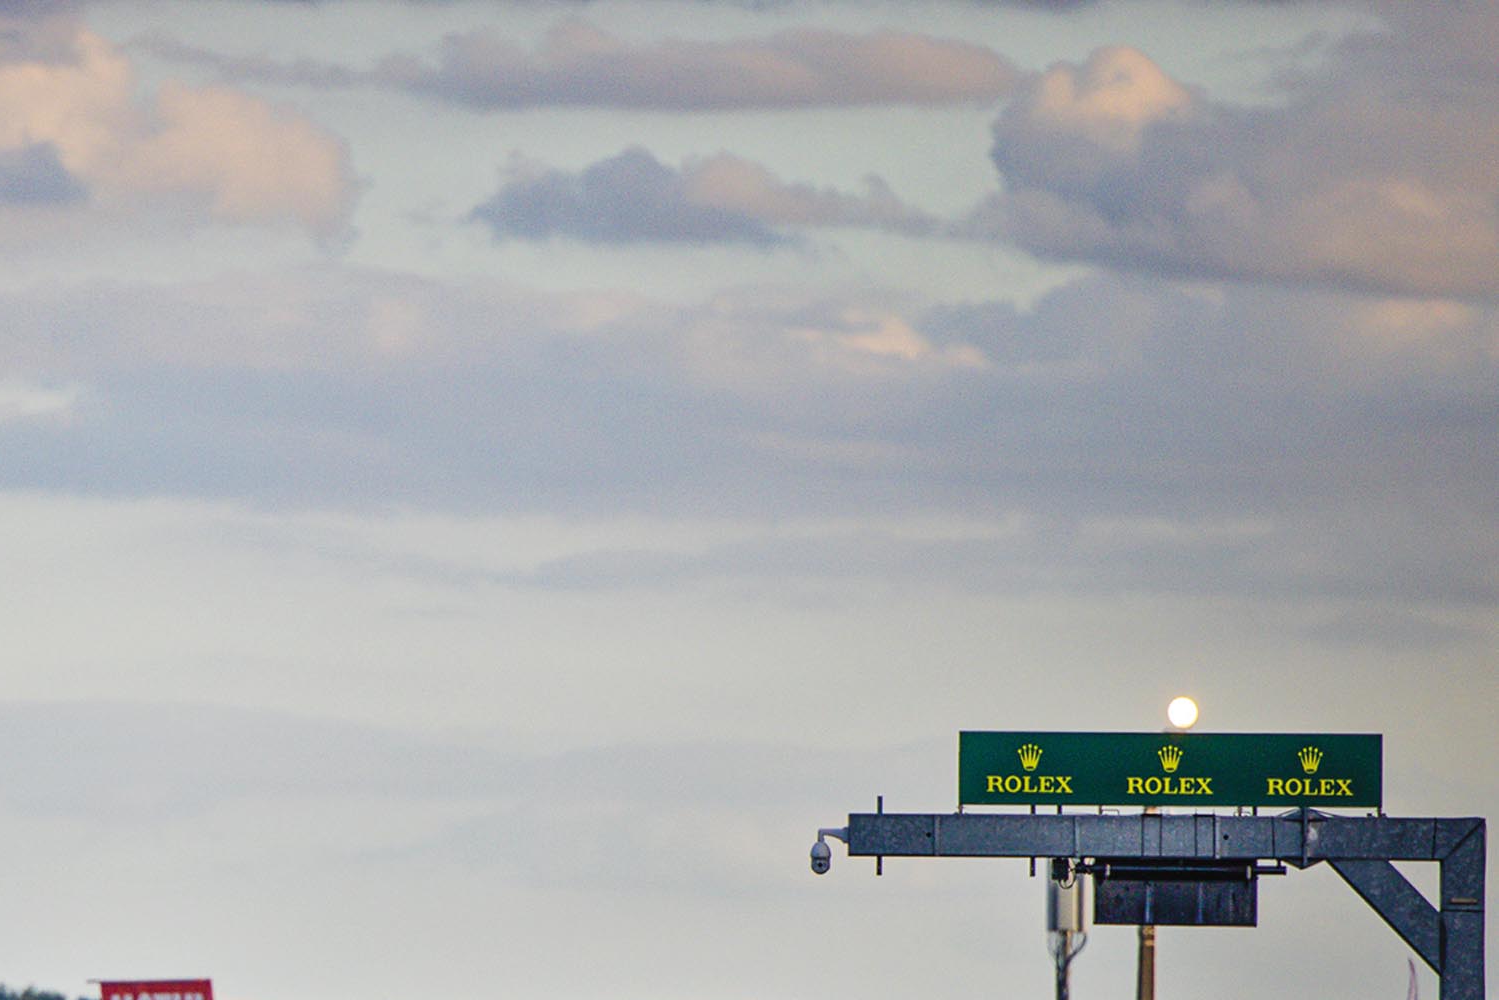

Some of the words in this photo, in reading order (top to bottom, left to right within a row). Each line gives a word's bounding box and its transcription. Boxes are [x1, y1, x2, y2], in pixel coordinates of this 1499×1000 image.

[986, 775, 1073, 795] ROLEX
[1126, 776, 1213, 796] ROLEX
[1267, 777, 1354, 797] ROLEX
